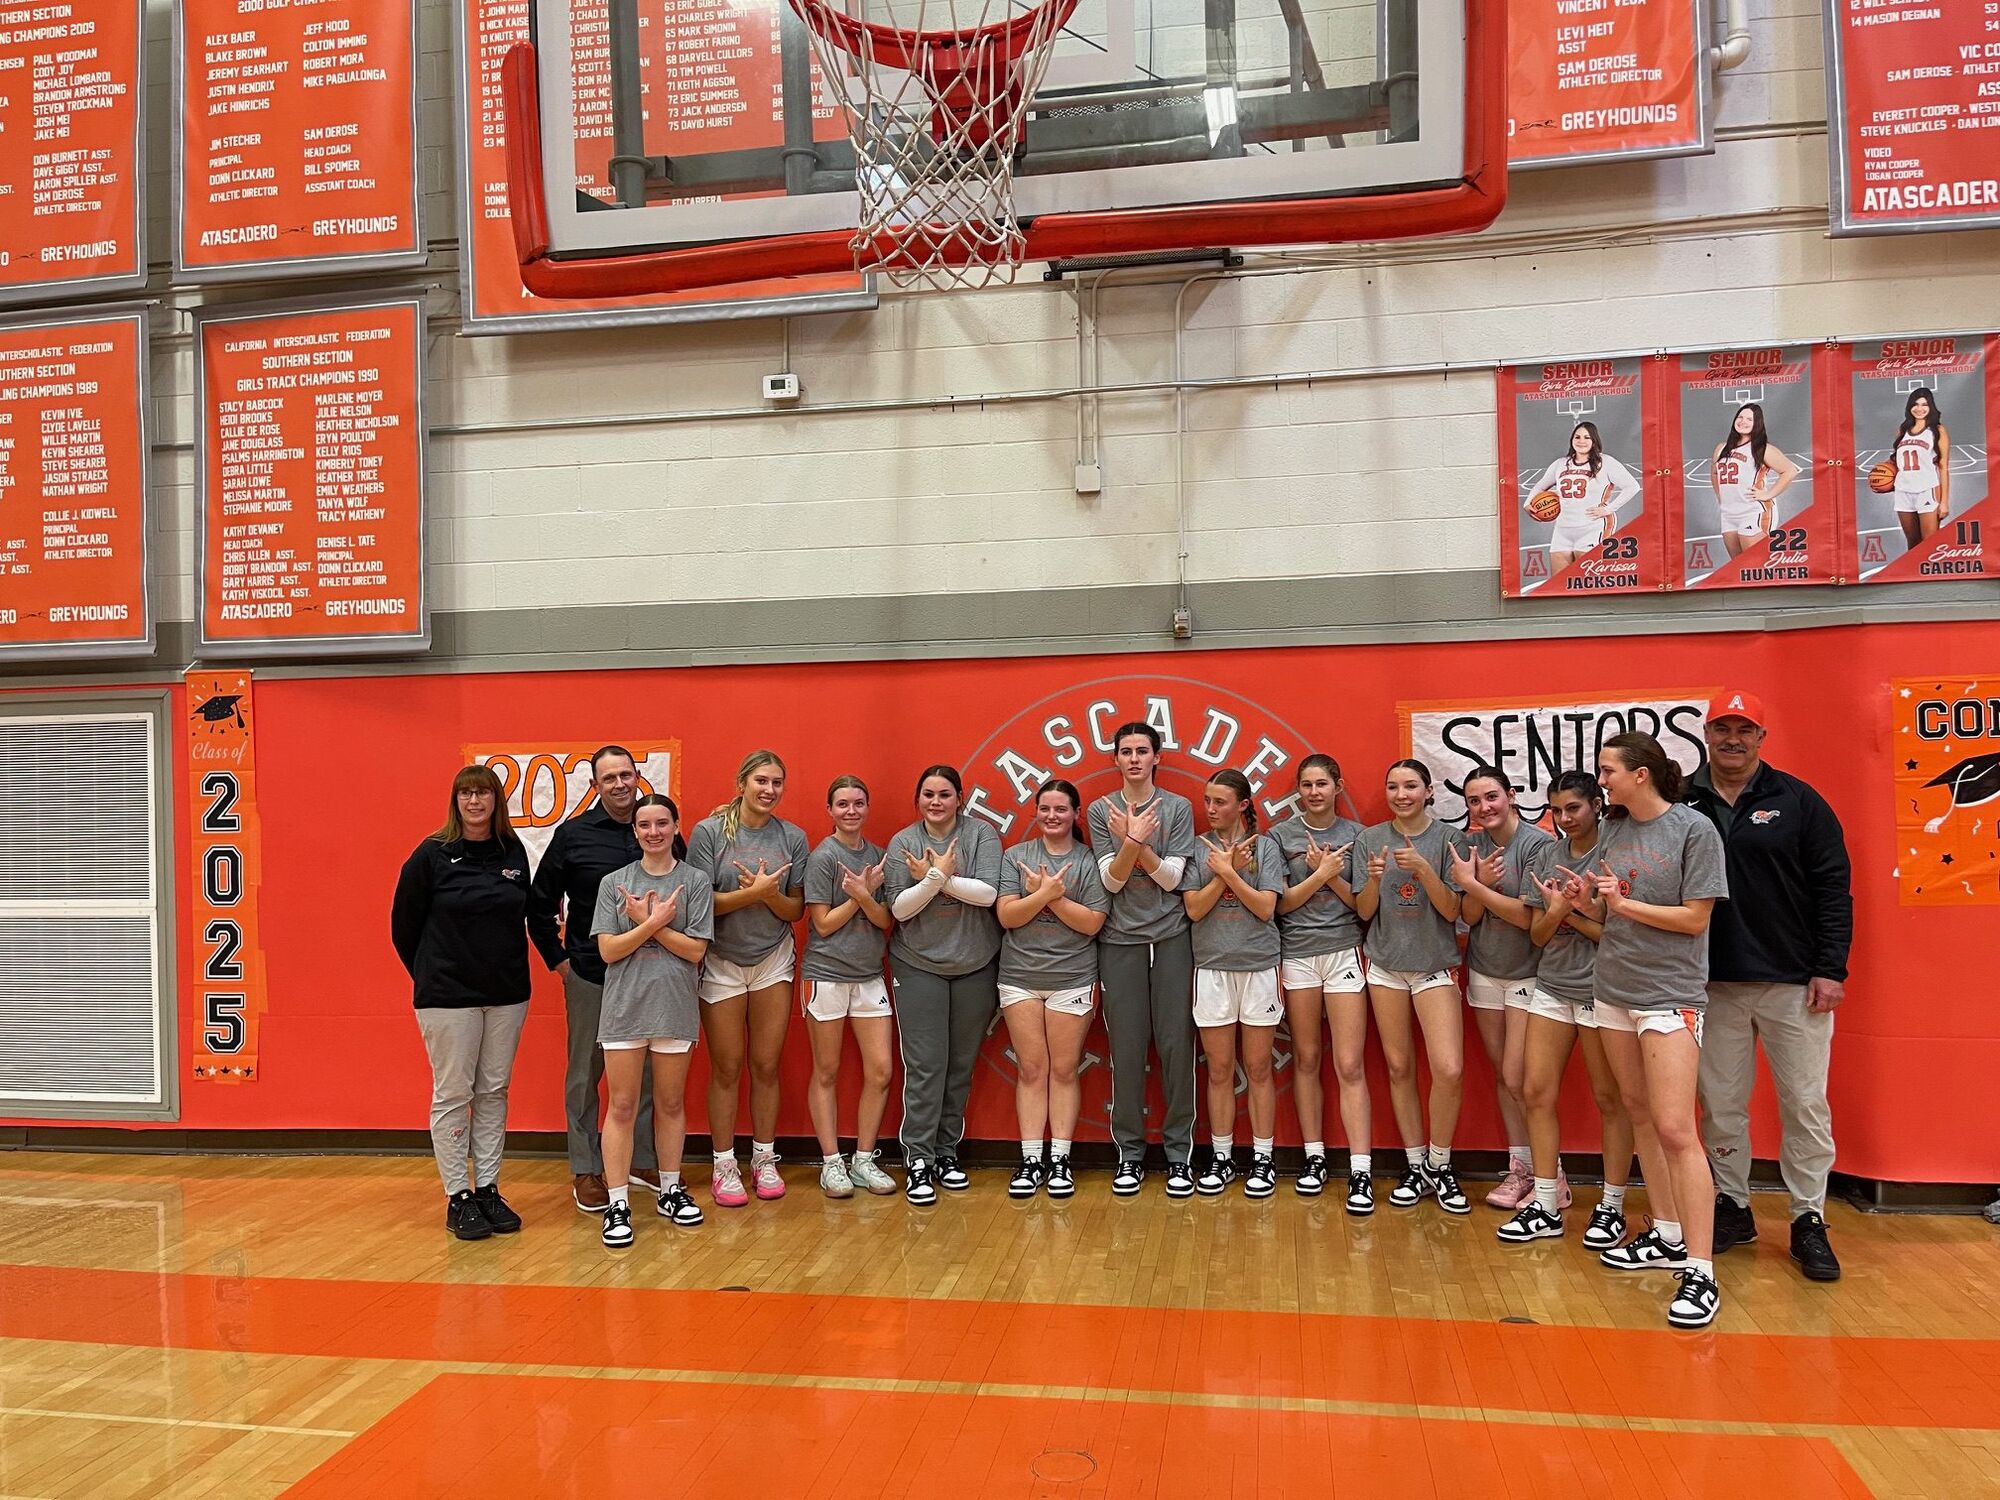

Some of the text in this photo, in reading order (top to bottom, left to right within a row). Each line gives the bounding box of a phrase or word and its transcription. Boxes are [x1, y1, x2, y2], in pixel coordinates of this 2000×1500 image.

[33, 5, 72, 20] SECTION
[238, 0, 263, 13] 2000
[1852, 9, 1940, 27] 14 MASON DEGNAN
[1986, 21, 1999, 31] 54
[14, 22, 94, 42] CHAMPIONS 2009
[665, 22, 736, 38] 65 MARK SIMONIN
[1557, 21, 1614, 41] LEVI HEIT
[206, 31, 255, 47] ALEX BAIER
[303, 39, 335, 53] COLTON
[206, 47, 267, 63] BLAKE BROWN
[666, 48, 753, 64] 68 DARVELL CULLORS
[1558, 42, 1585, 55] ASST
[1959, 45, 1982, 59] VIC
[33, 48, 97, 66] PAUL WOODMAN
[303, 53, 364, 70] ROBERT MORA
[206, 62, 288, 81] JEREMY GEARHART
[667, 64, 727, 78] 70 TIM POWELL
[1557, 55, 1637, 76] SAM DEROSE
[1888, 66, 1952, 81] SAM DEROSE
[667, 76, 735, 91] 71 KEITH AGGSON
[1558, 69, 1662, 90] ATHLETIC DIRECTOR
[34, 84, 126, 103] BRANDON ARMSTRONG
[668, 90, 739, 104] 72 ERIC SUMMERS
[34, 98, 112, 116] STEVEN TROCKMAN
[208, 98, 269, 116] JAKE HINRICHS
[668, 102, 747, 118] 73 JACK ANDERSEN
[1873, 105, 1960, 122] EVERETT COOPER
[668, 117, 733, 131] 75 DAVID HURST
[1561, 104, 1677, 131] GREYHOUNDS
[1861, 119, 1979, 137] STEVE KNUCKLES DAN
[1865, 147, 1891, 157] VIDEO
[1865, 159, 1919, 170] RYAN COOPER
[1866, 170, 1923, 180] LOGAN COOPER
[33, 188, 84, 203] SAM DEROSE
[200, 216, 398, 247] ATASCADERO GREYHOUNDS
[41, 240, 116, 262] GREYHOUNDS
[225, 328, 391, 352] CALIFORNIA INTERSCHOLASTIC FEDERATION
[1881, 339, 1955, 357] SENIOR
[69, 342, 113, 355] FEDERATION
[262, 350, 353, 369] SOUTHERN SECTION
[1709, 349, 1782, 369] SENIOR
[1876, 356, 1955, 371] Girls Basketball
[37, 363, 75, 377] SECTION
[1543, 361, 1613, 379] SENIOR
[1705, 366, 1782, 380] Girls Basketball
[1862, 369, 1914, 379] ATASCADERO
[1941, 364, 1974, 373] SCHOOL
[237, 369, 378, 392] GIRLS TRACK CHAMPIONS 1990
[1540, 378, 1613, 392] Girls Basketball
[1689, 375, 1800, 389] ATASCADERO HIGH SCHOOL
[20, 382, 98, 399] CHAMPIONS 1989
[1525, 391, 1575, 401] ATASCADERO
[219, 398, 283, 413] STACY BABCOCK
[316, 415, 399, 431] HEATHER NICHOLSON
[222, 448, 304, 464] PSALMS HARRINGTON
[316, 445, 362, 457] KELLY RIOS
[42, 457, 106, 471] STEVE SHEARER
[1903, 450, 1920, 471] 11
[1718, 463, 1738, 484] 22
[42, 482, 108, 496] NATHAN WRIGHT
[1560, 479, 1586, 498] 23
[43, 508, 117, 521] COLLIE KIDWELL
[317, 509, 385, 522] TRACY MATHENY
[224, 524, 284, 537] KATHY DEVANEY
[1957, 521, 1981, 545] 11
[1602, 537, 1638, 559] 23
[1769, 529, 1807, 551] 22
[1688, 543, 1713, 568] A
[1862, 536, 1886, 562] A
[1928, 544, 1983, 562] Sarah
[1524, 551, 1547, 576] A
[1764, 551, 1809, 568] Julie
[1580, 559, 1638, 577] Karissa
[1741, 567, 1809, 582] HUNTER
[1920, 560, 1984, 576] GARCIA
[1567, 574, 1638, 589] JACKSON
[50, 605, 128, 622] GREYHOUNDS
[221, 599, 405, 620] ATASCADERO GREYHOUNDS
[1728, 695, 1744, 710] A
[192, 740, 248, 765] Class of
[962, 696, 1301, 834] TASCADE
